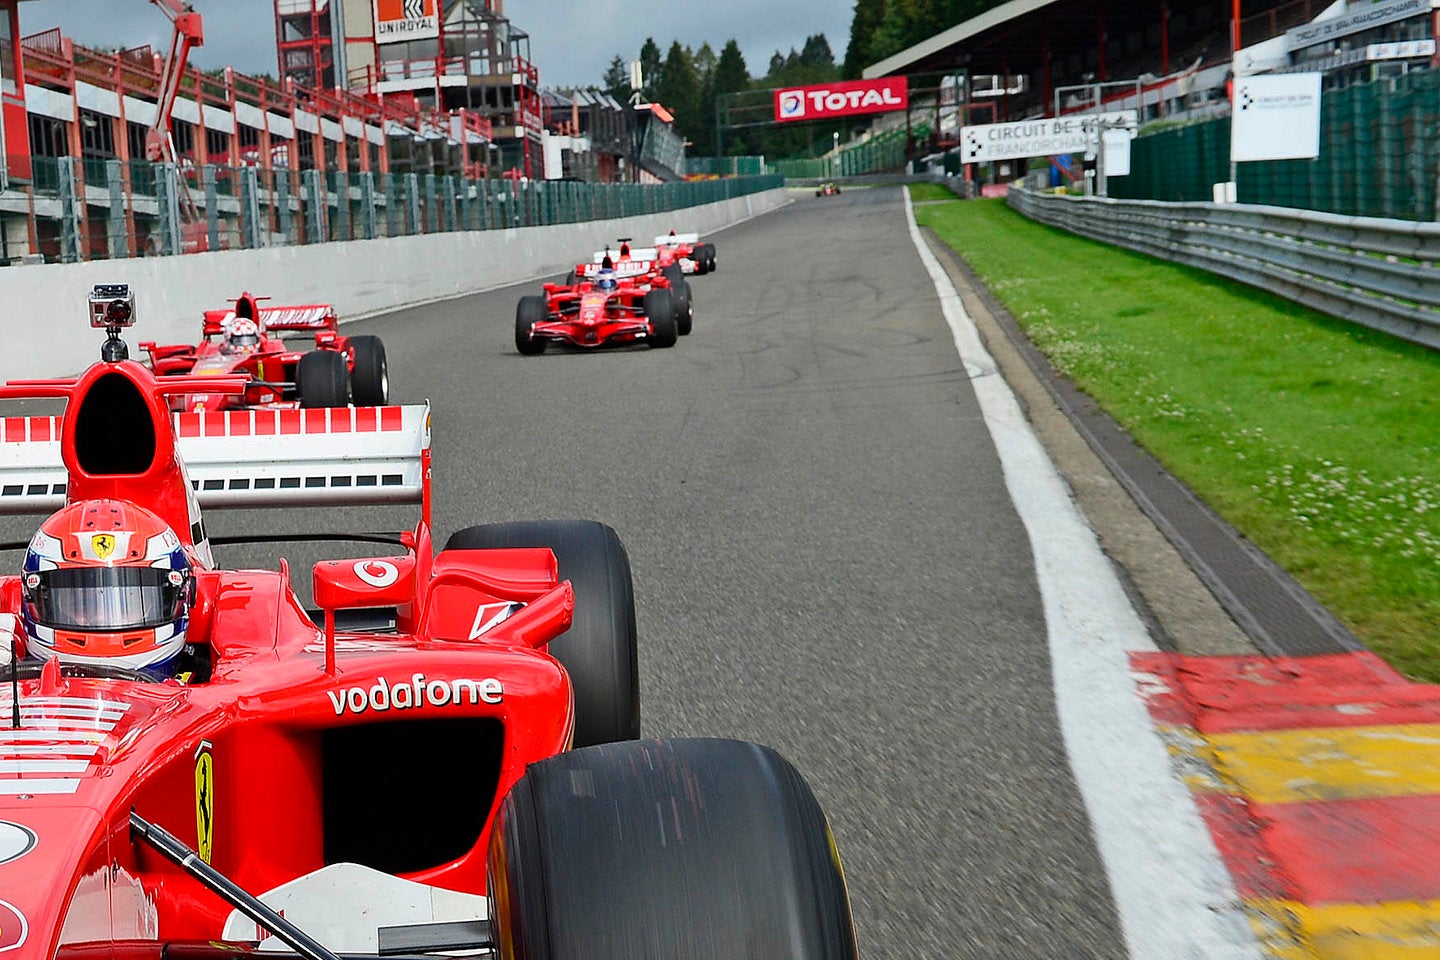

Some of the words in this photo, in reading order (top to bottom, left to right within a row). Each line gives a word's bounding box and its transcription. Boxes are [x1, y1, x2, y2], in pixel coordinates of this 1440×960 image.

[378, 18, 433, 34] UNIROYAL
[807, 87, 902, 112] TOTAL
[988, 123, 1046, 141] CIRCUIT
[327, 673, 504, 715] vodafone
